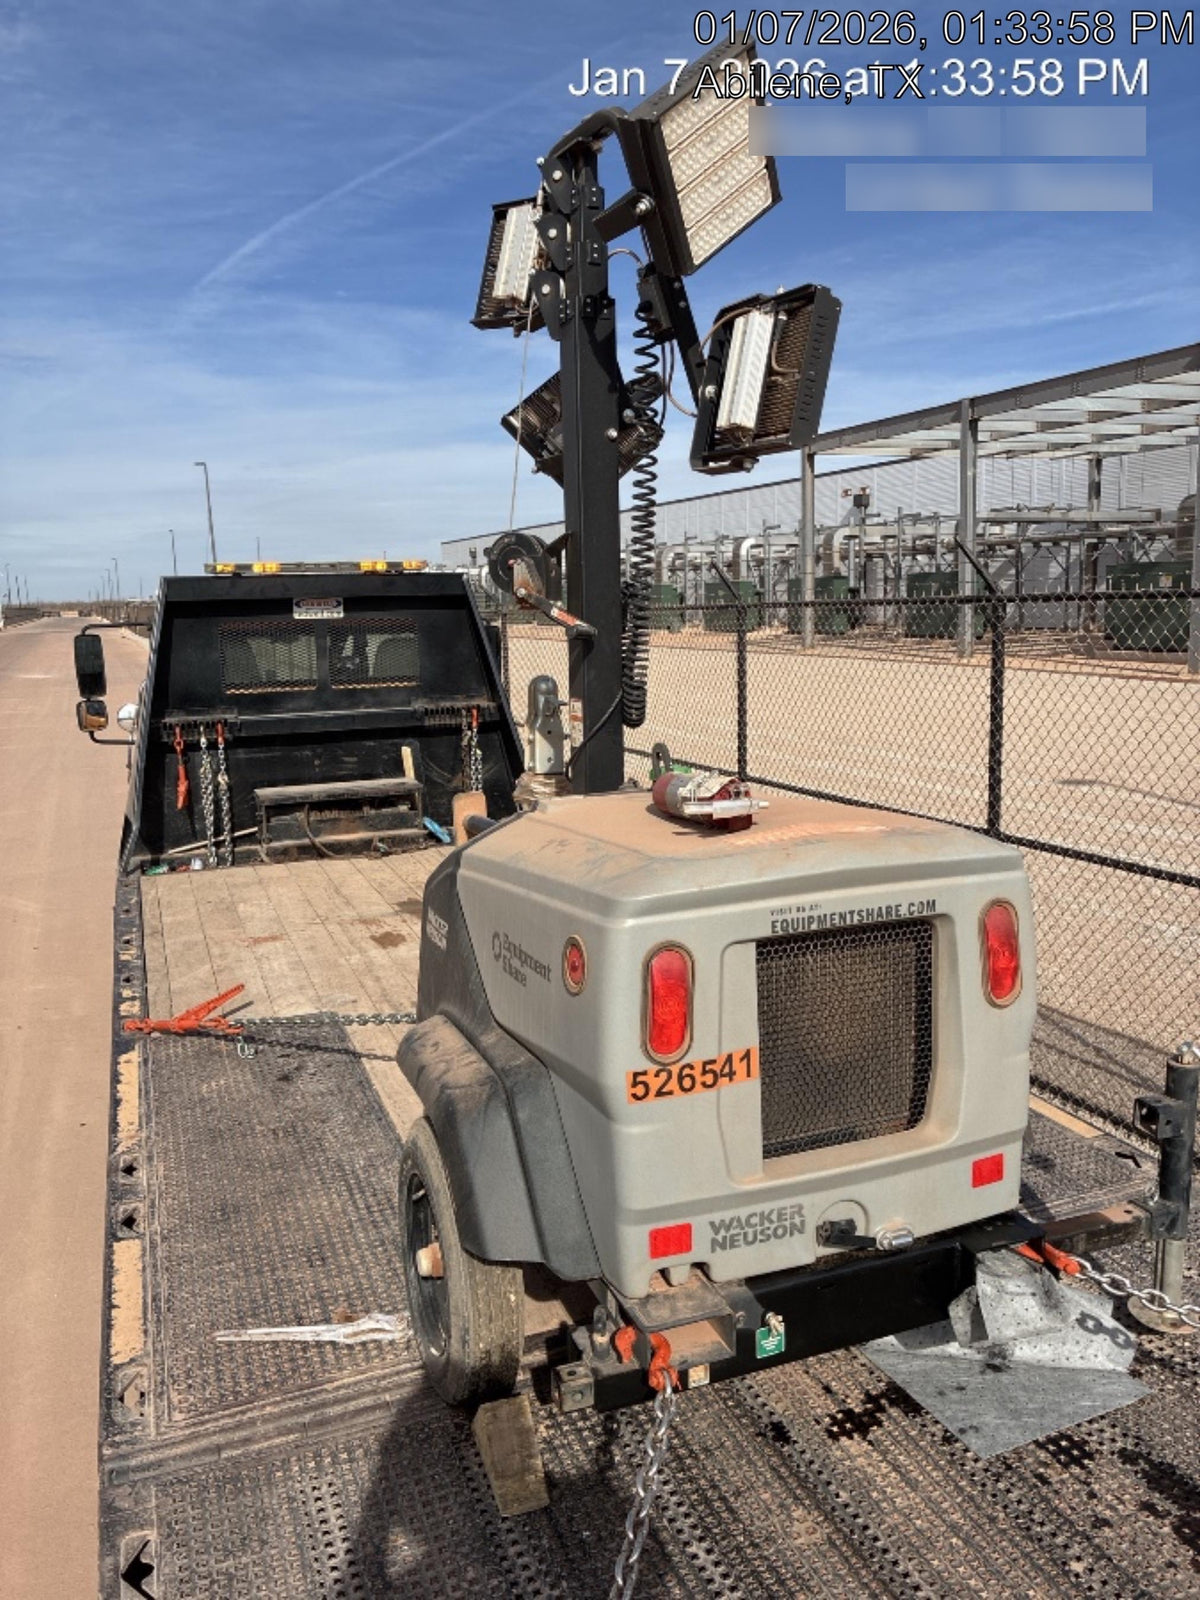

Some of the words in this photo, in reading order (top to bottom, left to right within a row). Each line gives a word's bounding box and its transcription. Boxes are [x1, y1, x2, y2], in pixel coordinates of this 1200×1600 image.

[770, 899, 937, 935] EQUIPMENTSHARE.COM
[630, 1048, 753, 1101] 526541
[709, 1203, 805, 1237] WACKER
[710, 1219, 806, 1254] NEUSON
